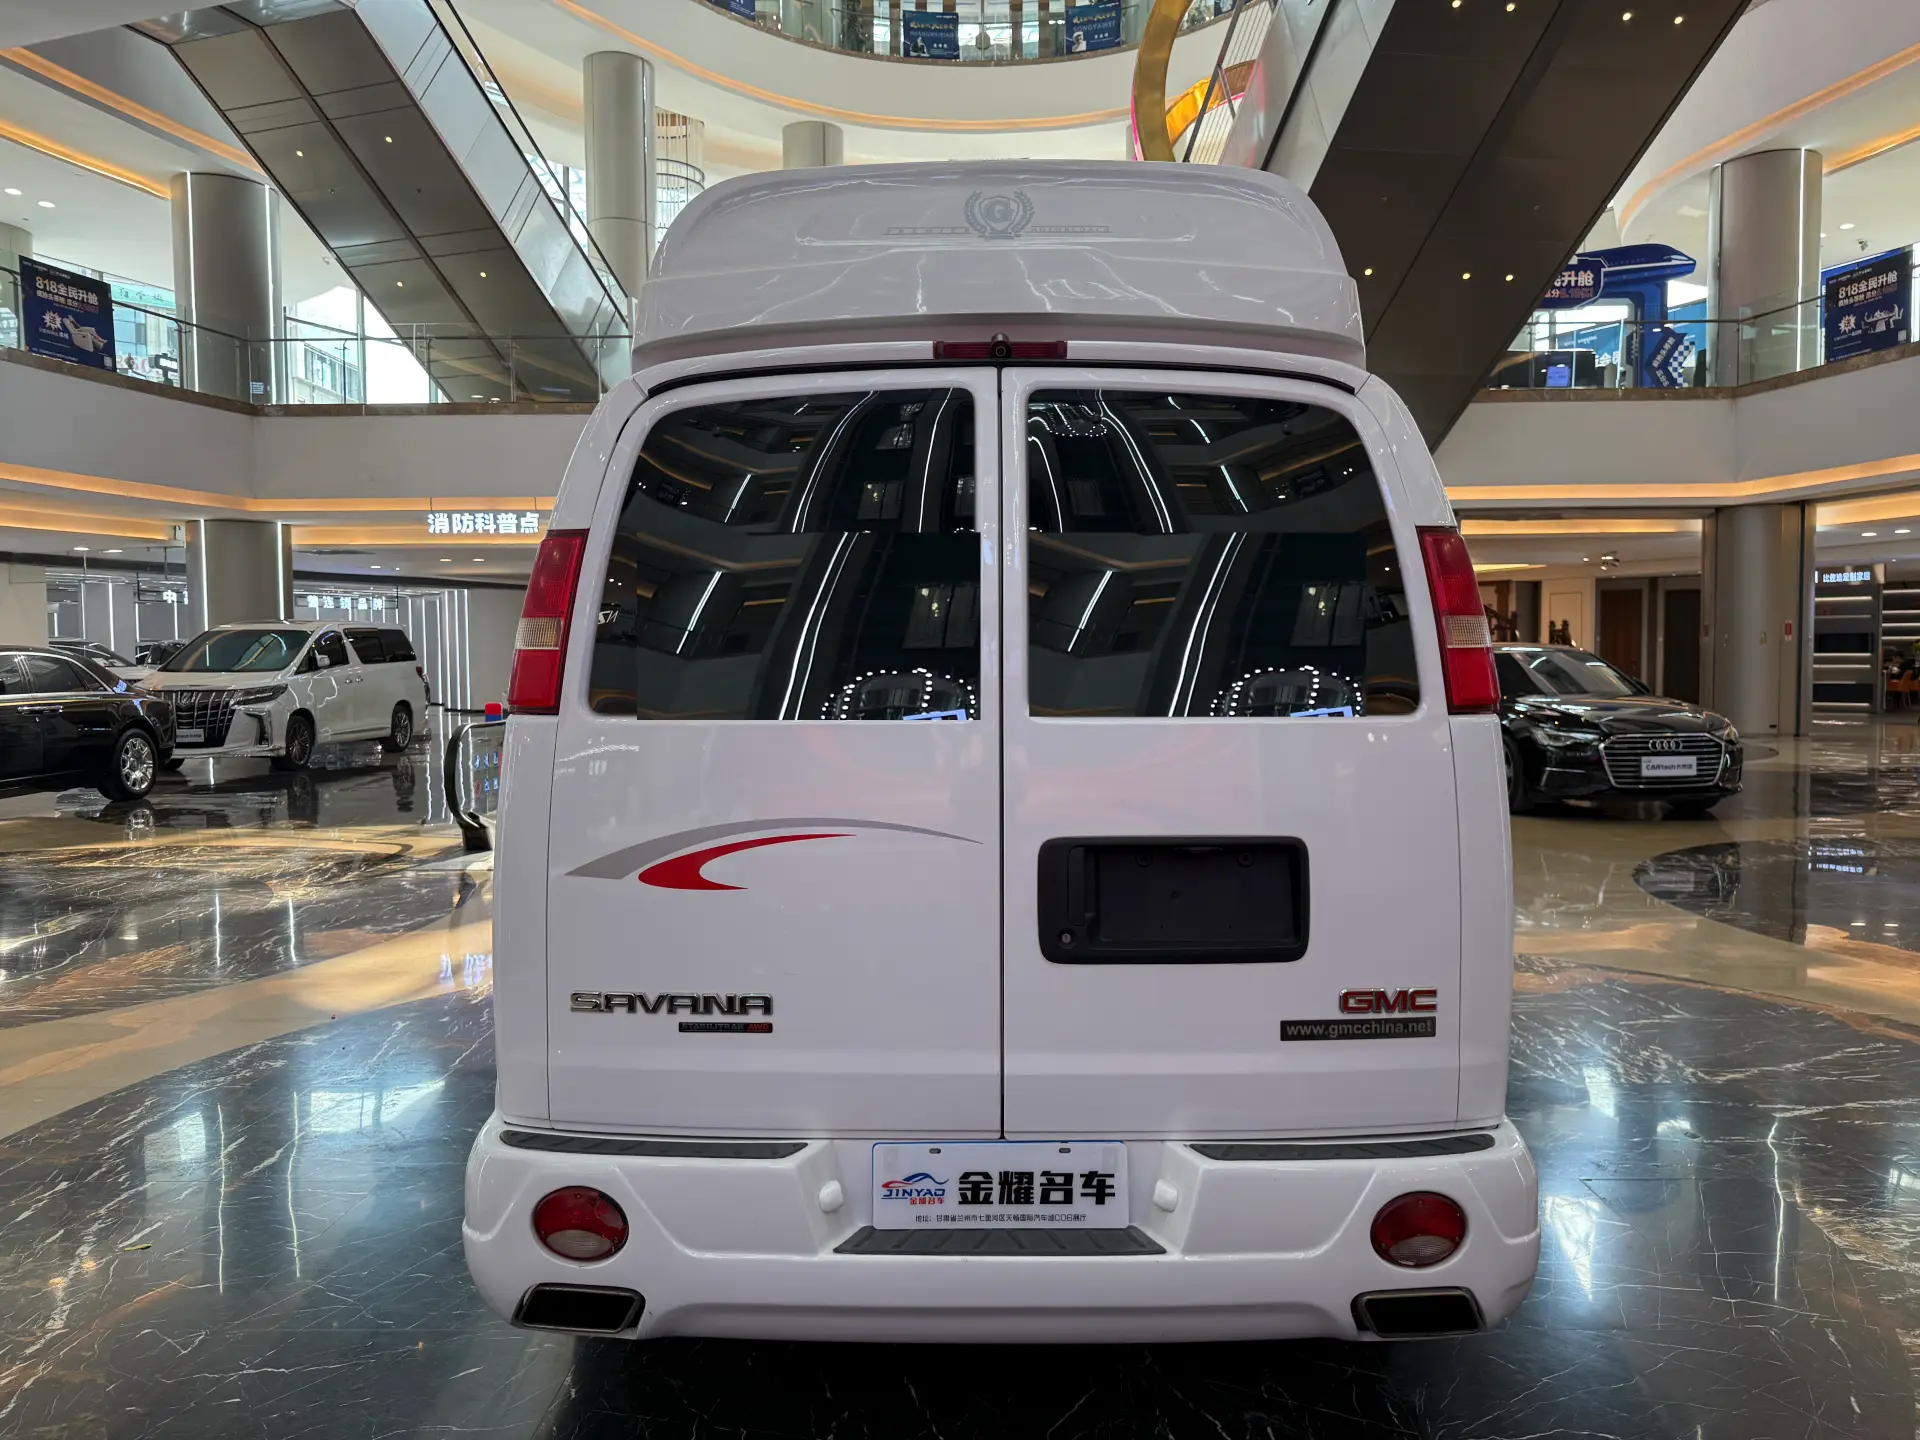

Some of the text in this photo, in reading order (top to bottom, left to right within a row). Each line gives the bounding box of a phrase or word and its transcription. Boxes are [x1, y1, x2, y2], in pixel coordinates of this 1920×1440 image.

[36, 276, 98, 305] 818全民升舱
[1838, 270, 1898, 299] 818全民升舱
[427, 512, 540, 534] 消防科普点
[571, 991, 774, 1015] SAVANA
[1339, 987, 1438, 1014] GMC
[748, 1023, 769, 1031] AWD
[1286, 1020, 1432, 1038] www.gmcchina.net
[882, 1188, 946, 1197] JINYAO
[958, 1170, 1116, 1206] 金耀名车
